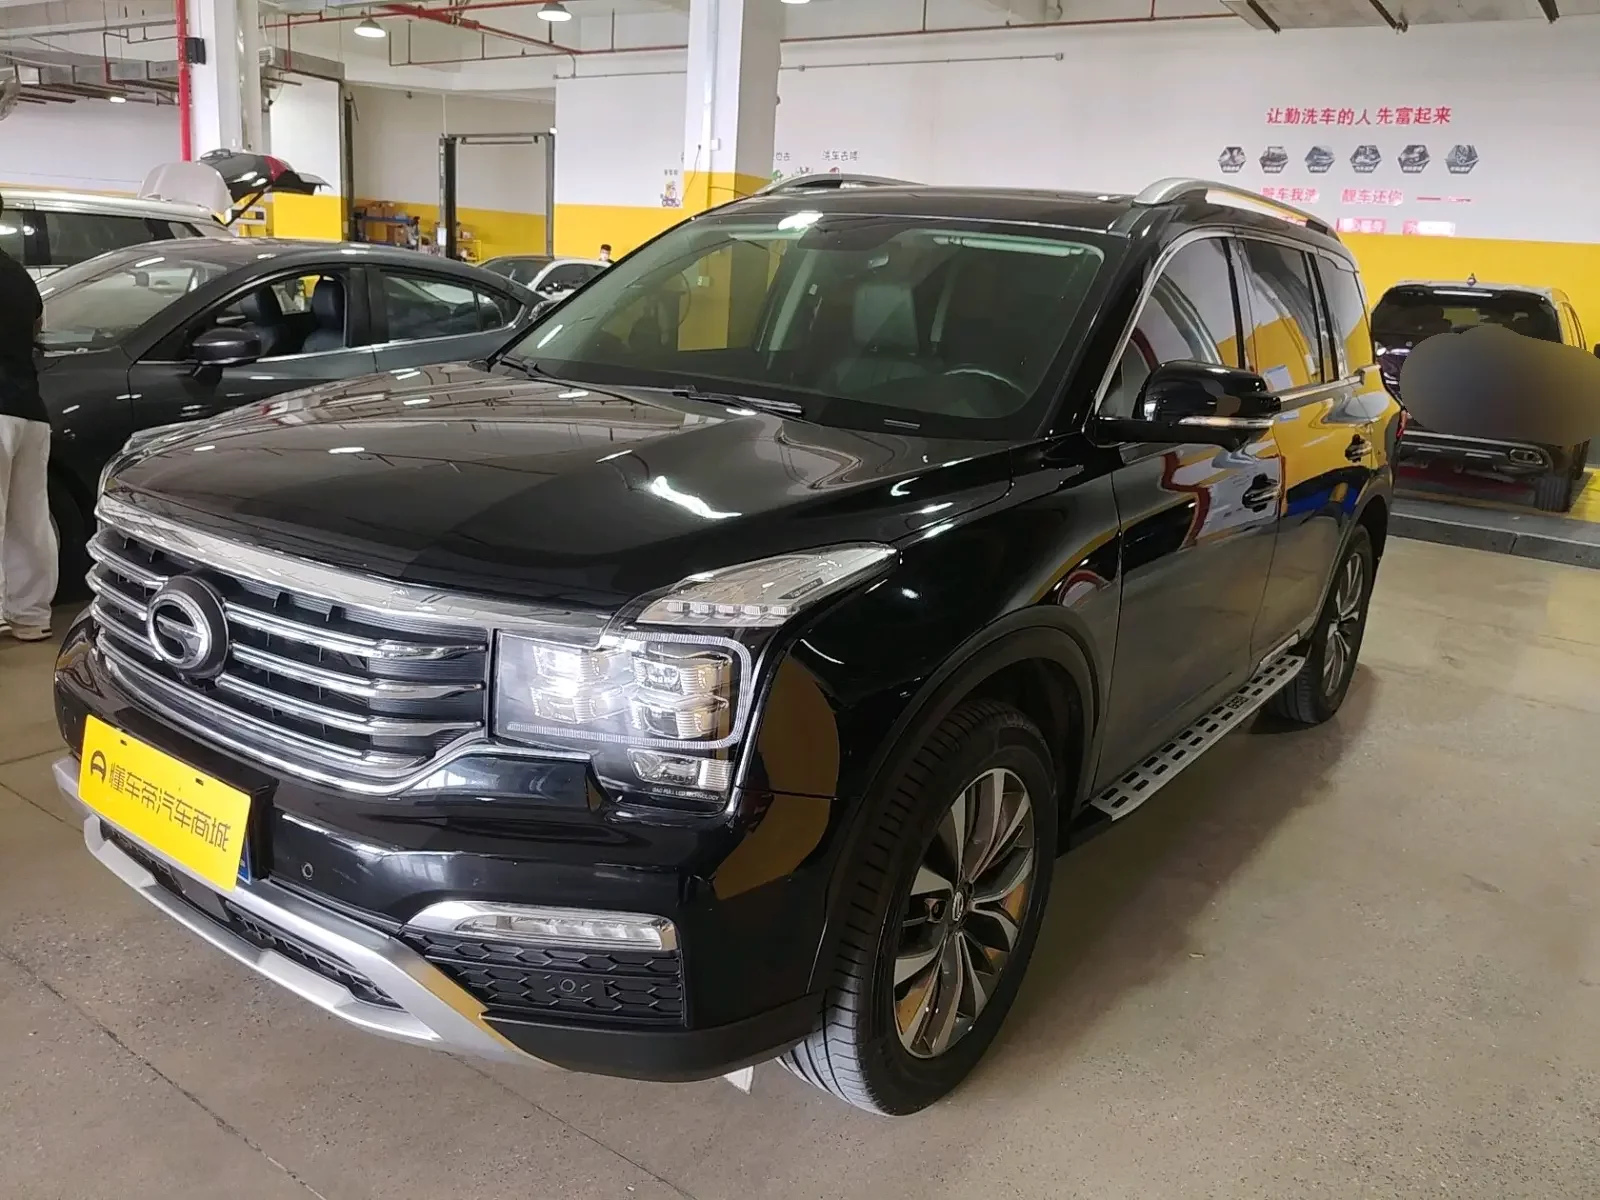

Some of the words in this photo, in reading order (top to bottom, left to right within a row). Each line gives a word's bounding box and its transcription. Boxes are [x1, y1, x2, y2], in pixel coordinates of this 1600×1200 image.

[109, 763, 231, 852] 懂车帝汽车商城
